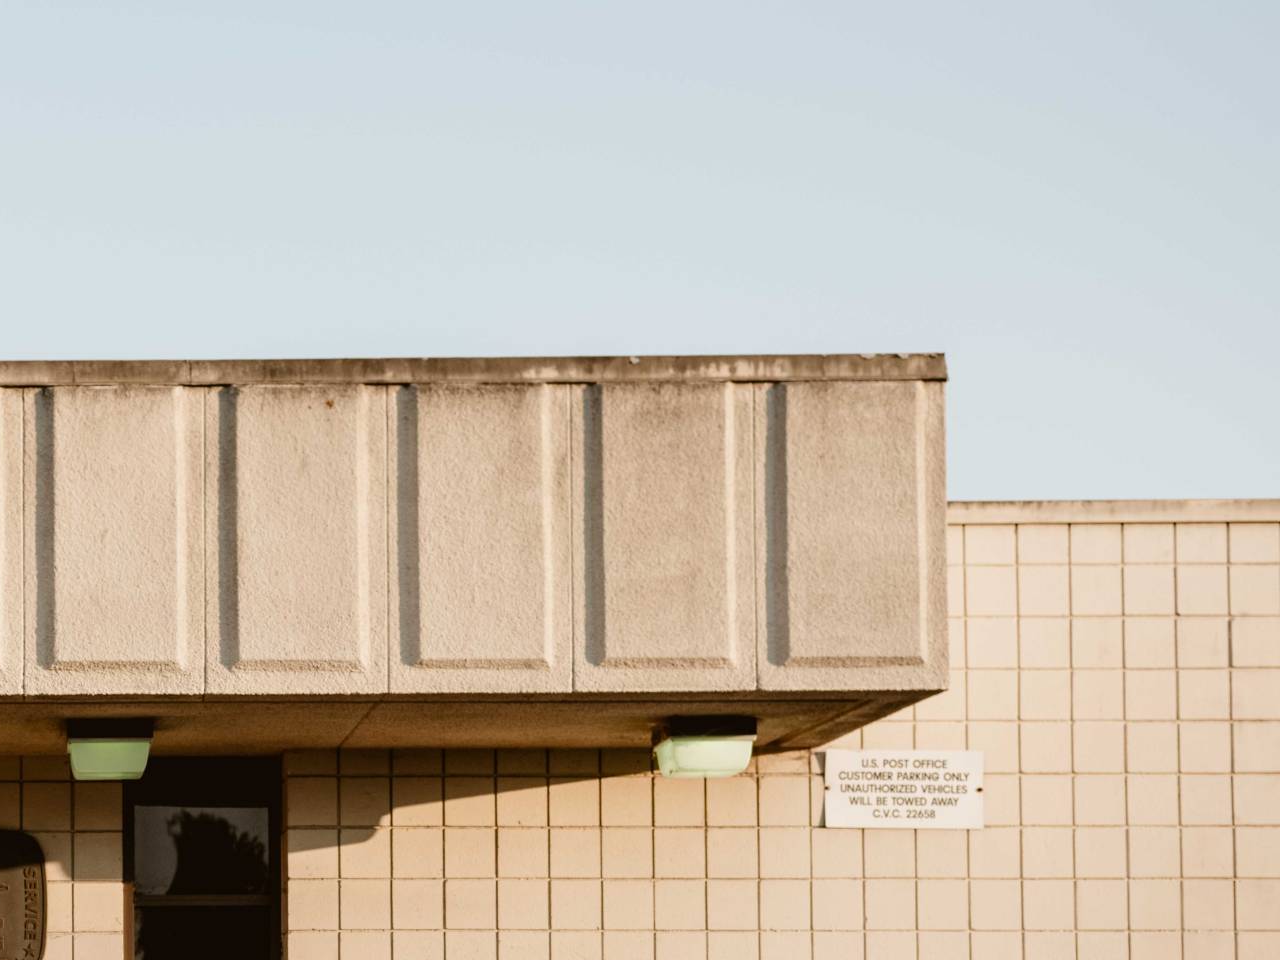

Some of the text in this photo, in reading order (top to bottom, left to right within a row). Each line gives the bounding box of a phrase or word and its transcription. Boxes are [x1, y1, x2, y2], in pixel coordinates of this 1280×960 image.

[861, 759, 947, 769] U.S. POST OFFICE
[838, 771, 969, 781] CUSTOMER PARKING ONLY
[840, 784, 968, 794] UNAUTHORIZED VEHICLES
[849, 797, 959, 806] WILL BE TOWED AWAY
[872, 809, 936, 819] C.V.C. 22658
[23, 867, 38, 941] SERVICE
